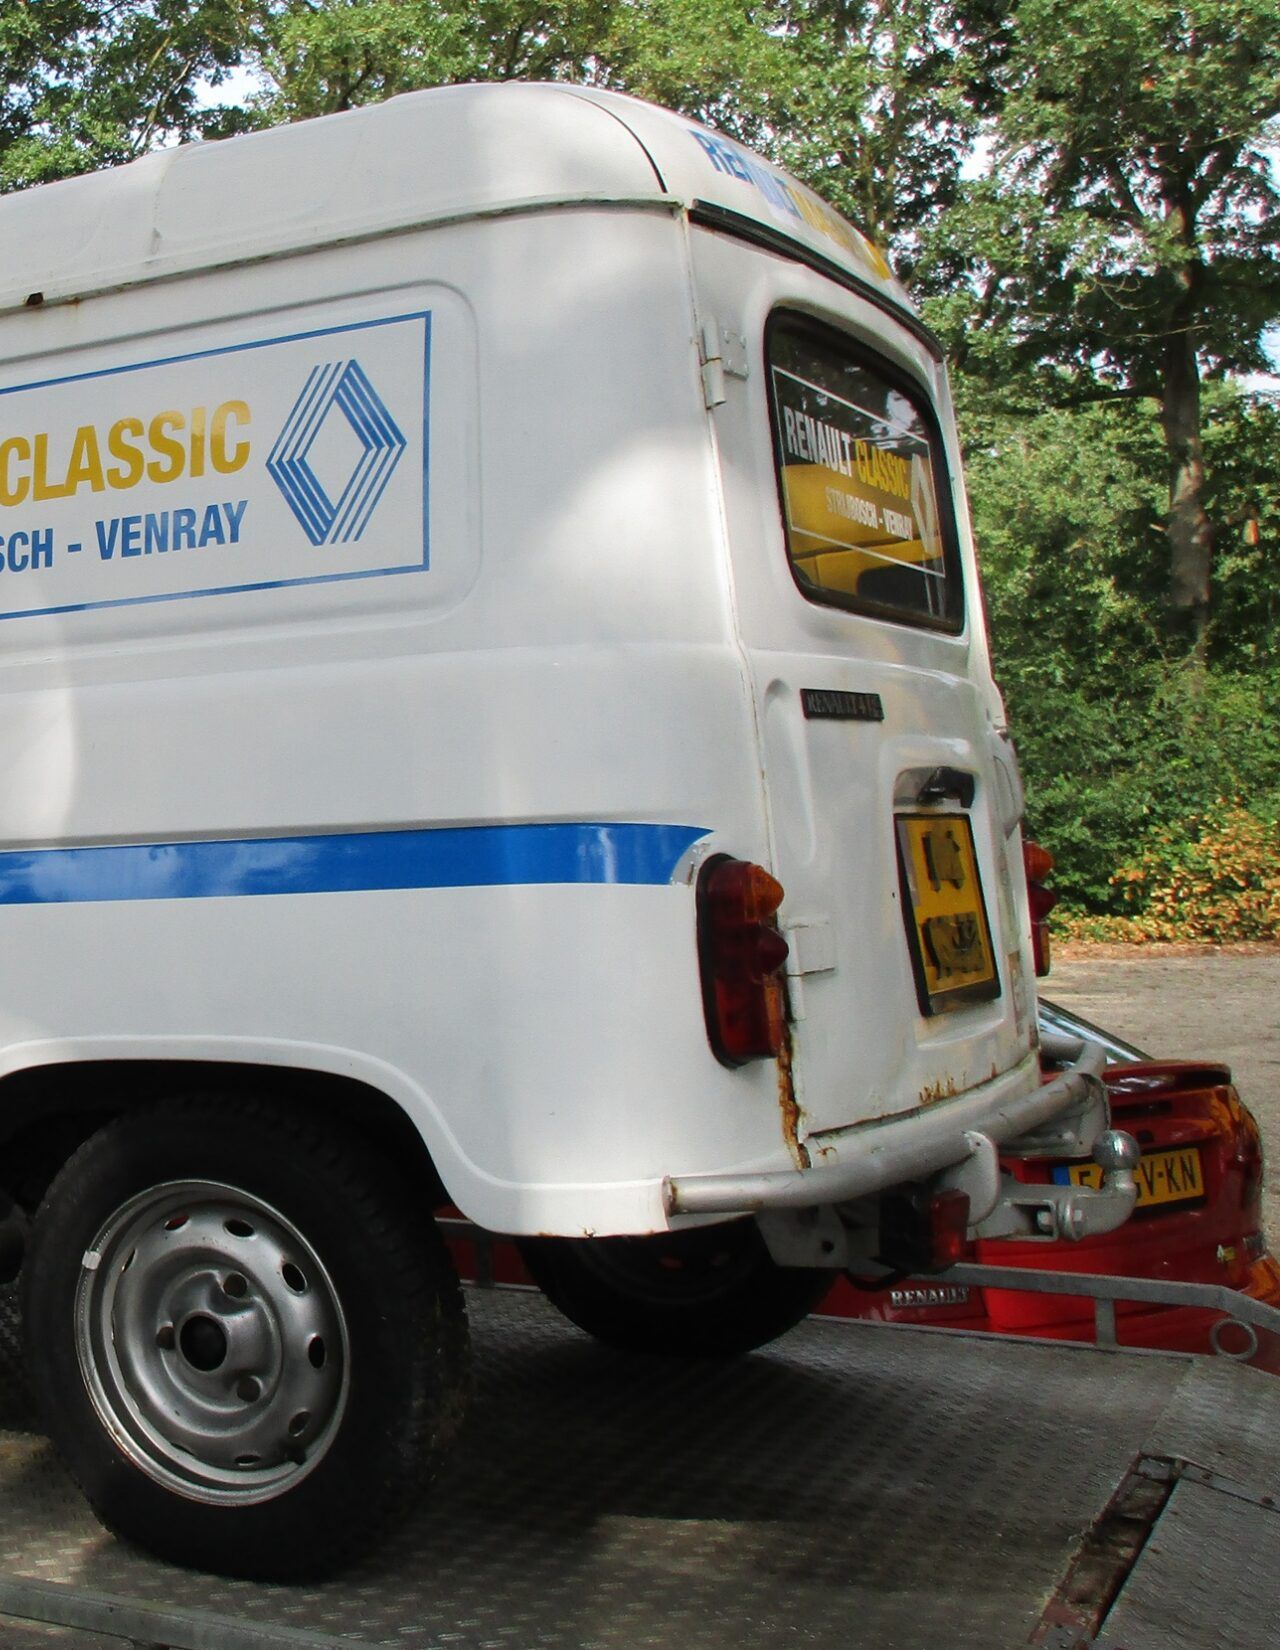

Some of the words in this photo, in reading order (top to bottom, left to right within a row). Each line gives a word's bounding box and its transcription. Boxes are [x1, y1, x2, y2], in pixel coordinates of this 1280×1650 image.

[784, 405, 852, 477] RENAULT
[854, 438, 910, 500] CLASSIC
[96, 500, 249, 560] VENRAY
[890, 1287, 969, 1306] RENAULT
